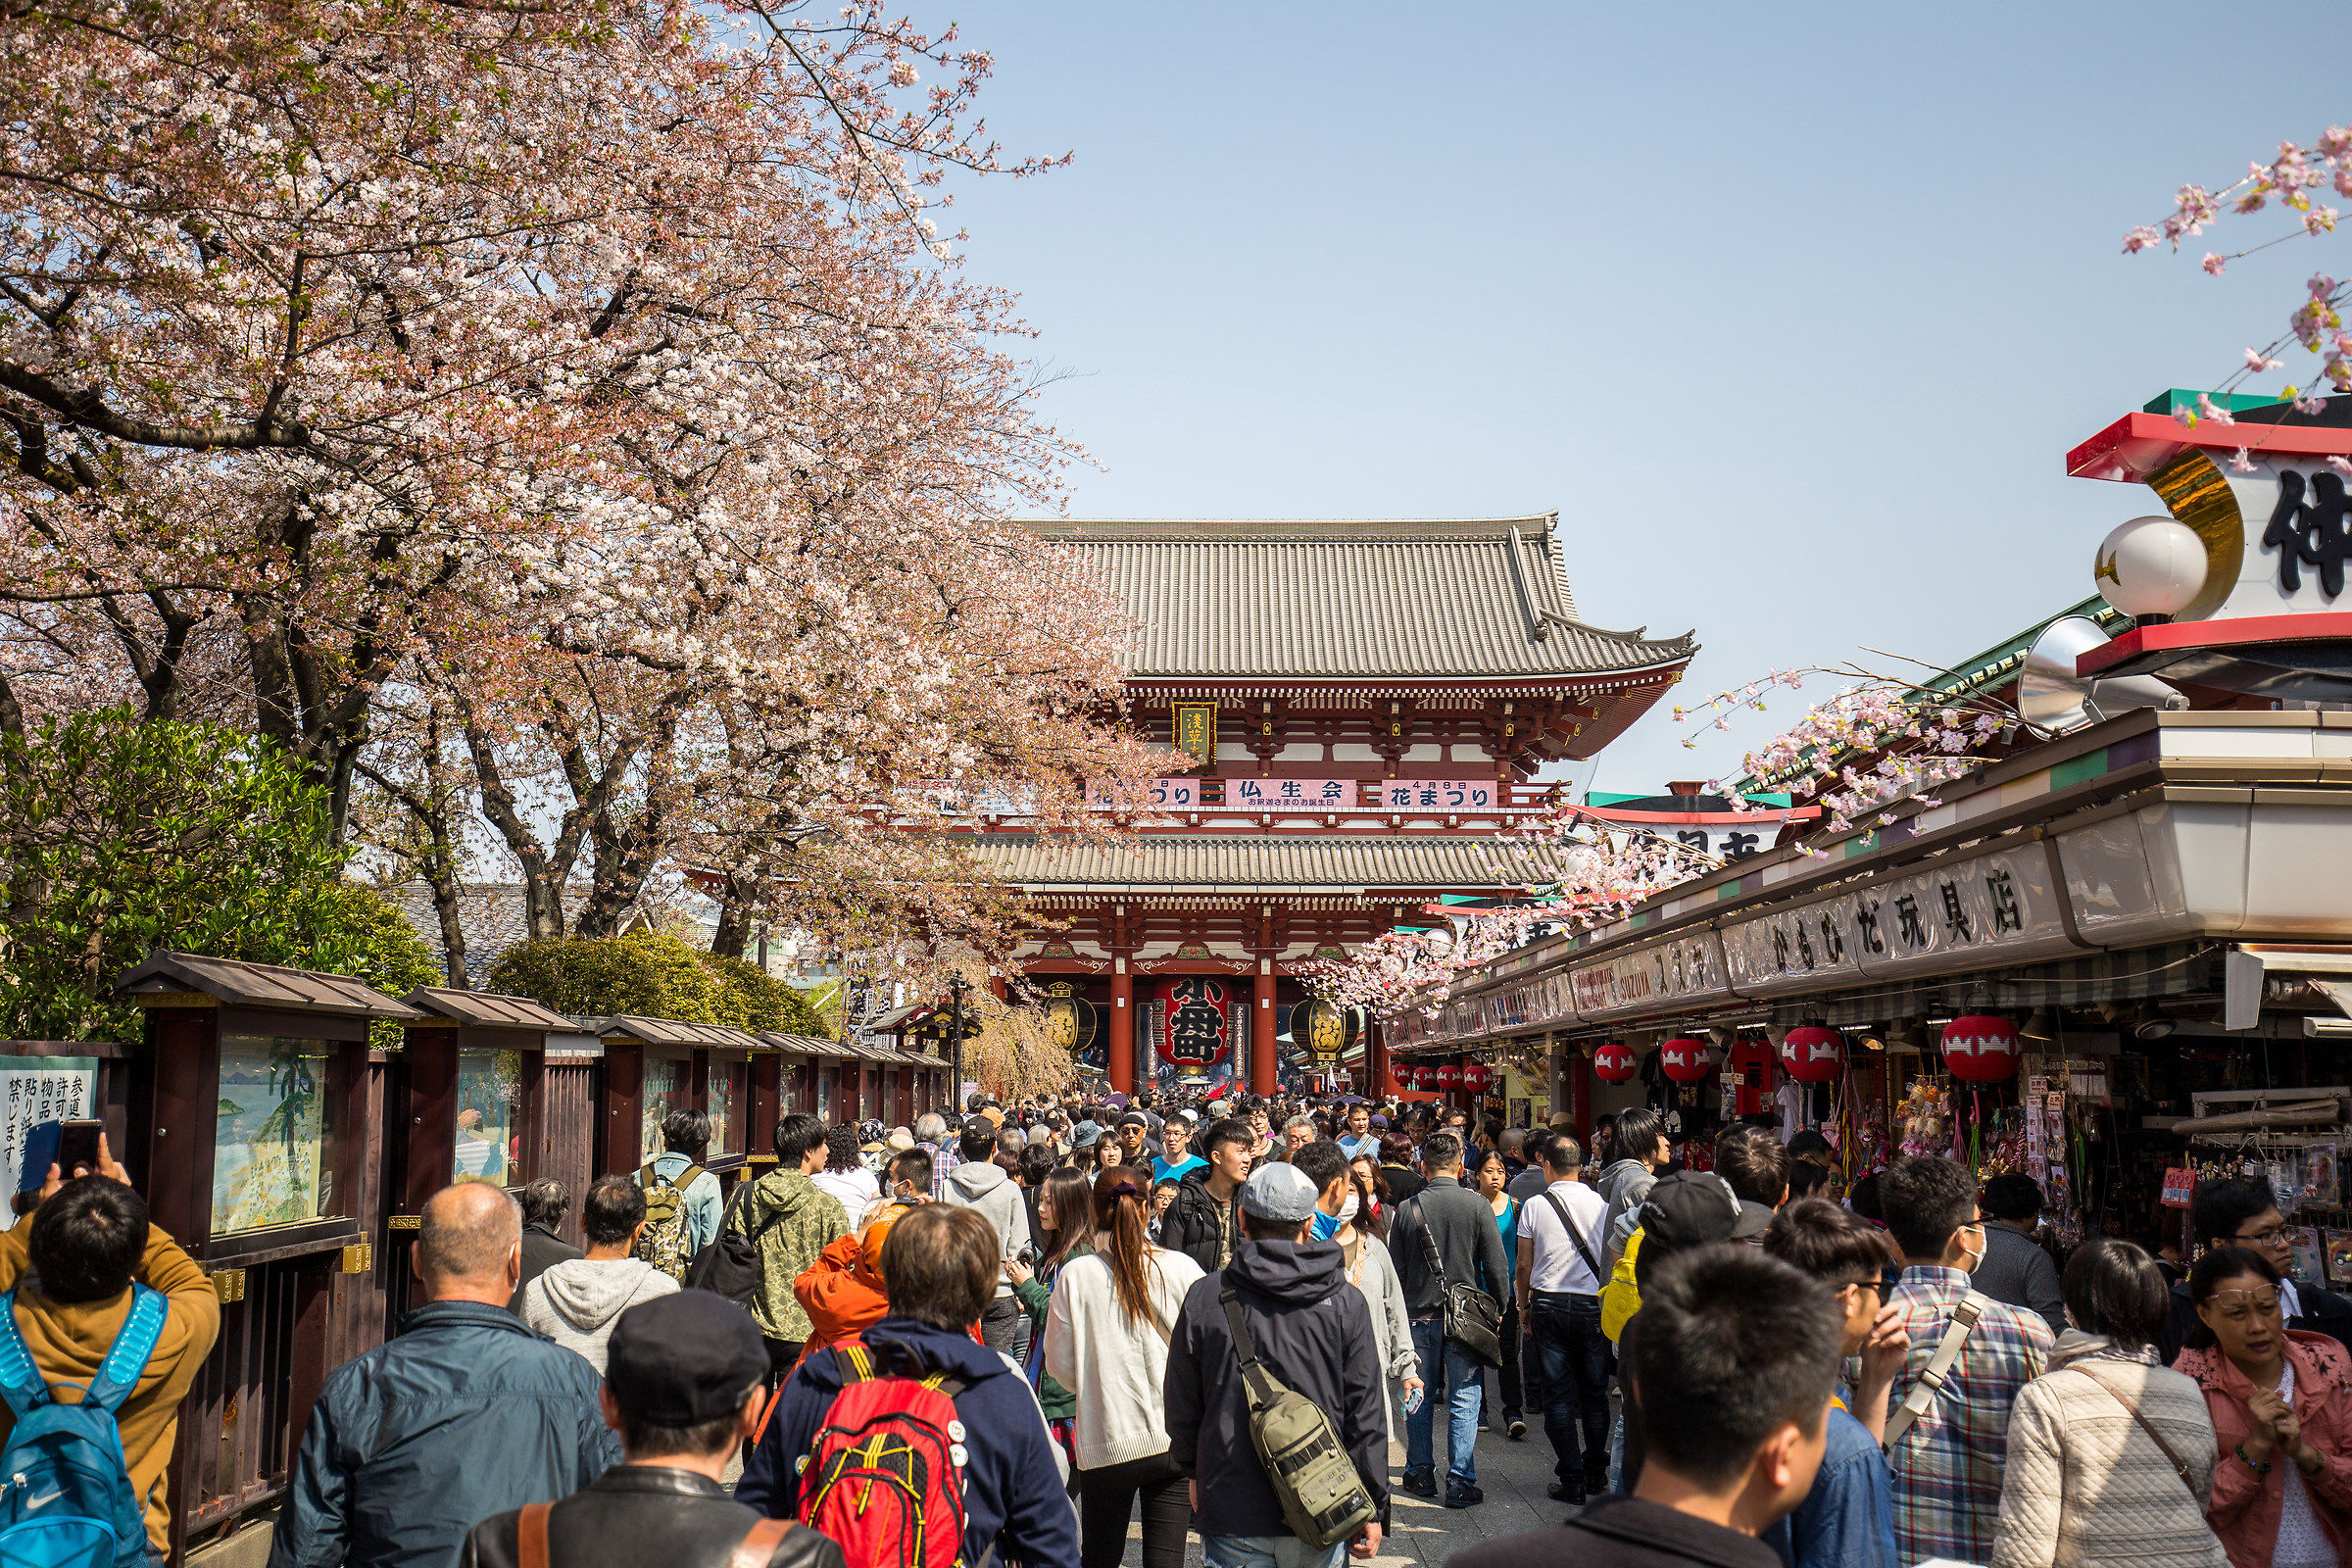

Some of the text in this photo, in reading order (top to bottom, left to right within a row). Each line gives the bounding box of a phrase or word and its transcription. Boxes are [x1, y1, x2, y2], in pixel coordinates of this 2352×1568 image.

[1239, 780, 1344, 799] 仏生会
[1391, 788, 1488, 806] 花まつり
[1620, 970, 1651, 1001] SUZUYA
